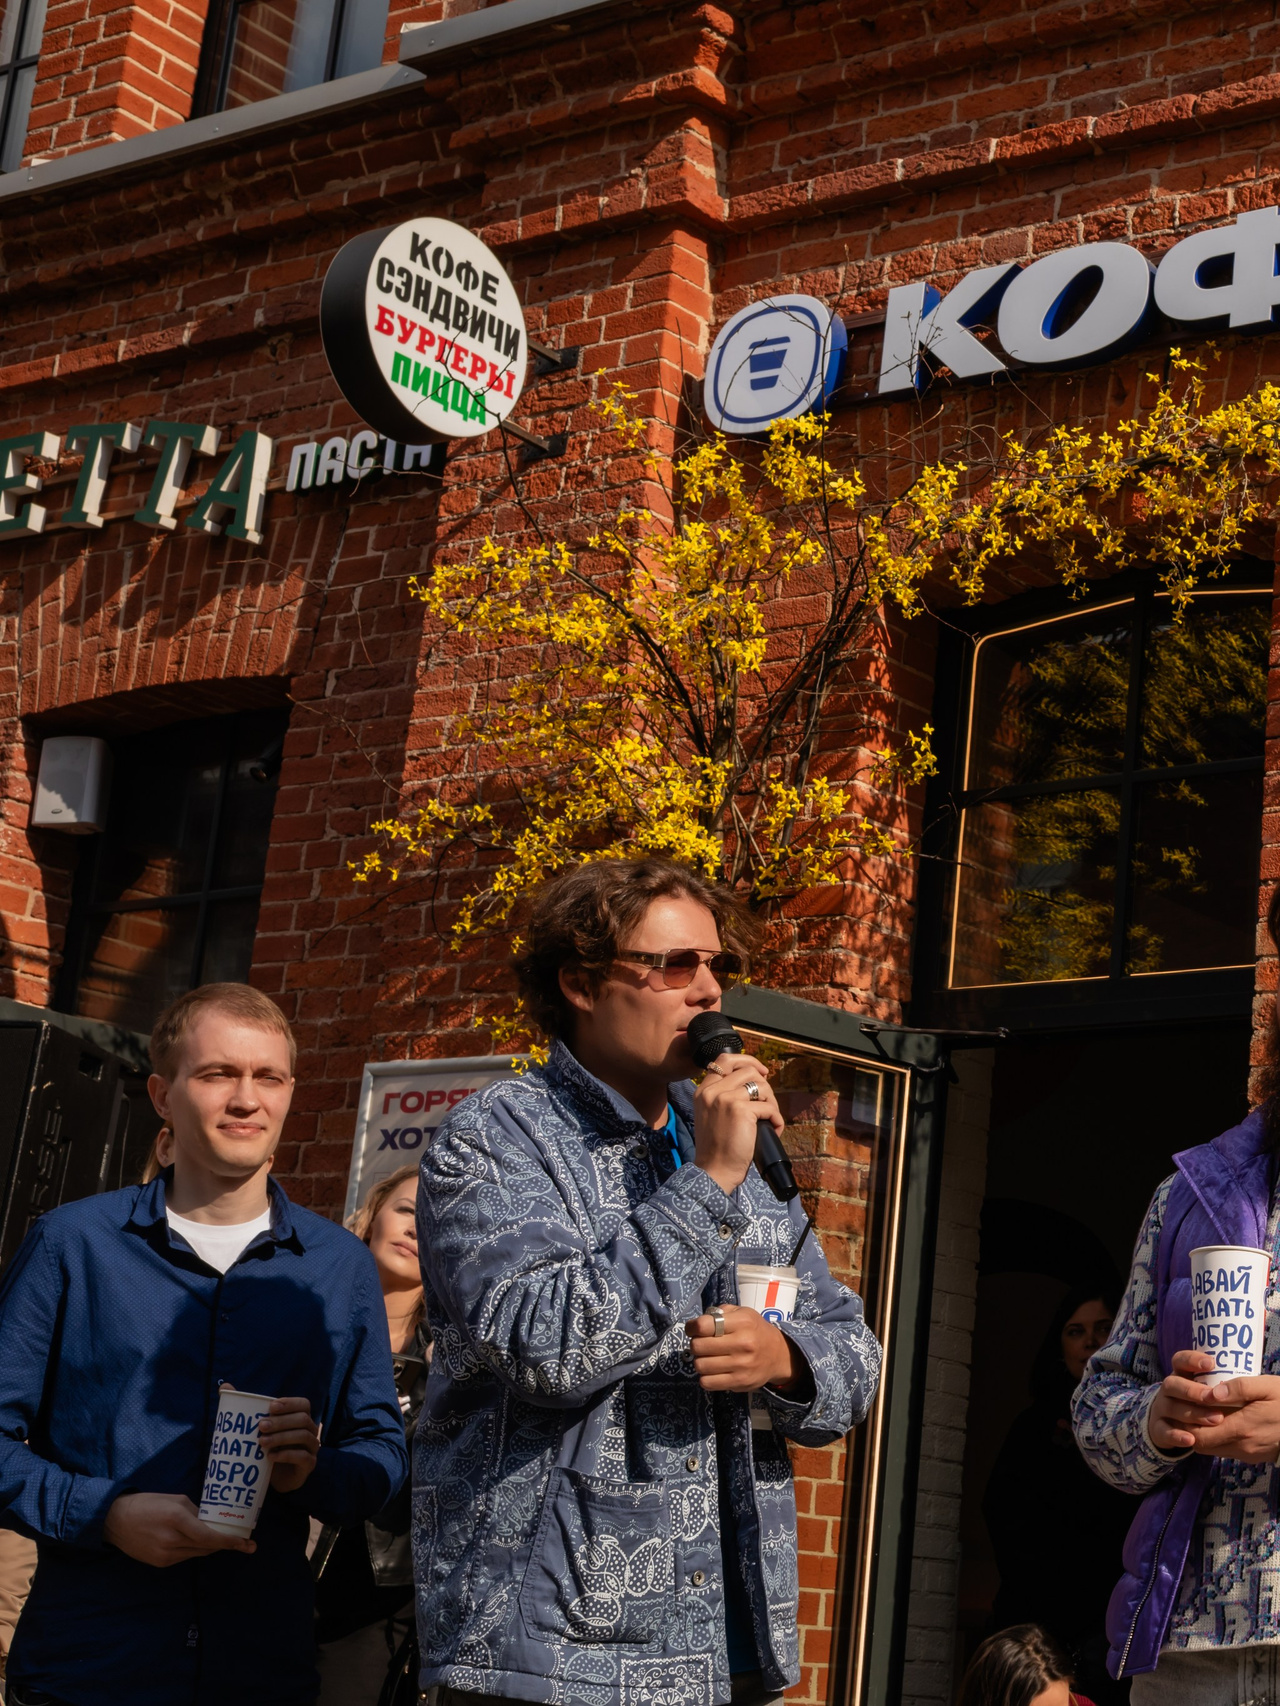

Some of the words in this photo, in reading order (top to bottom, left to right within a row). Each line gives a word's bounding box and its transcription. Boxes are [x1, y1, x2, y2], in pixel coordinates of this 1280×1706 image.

[409, 231, 500, 307] КОФЕ
[375, 256, 521, 362] СЭНДВИЧИ
[374, 303, 517, 400] БУРГЕРЫ
[390, 350, 487, 426] ПИЦЦА
[381, 1088, 478, 1115] ГОРЯ
[211, 1436, 265, 1461] ЕЛАТЬ
[215, 1411, 270, 1438] АВАЙ
[205, 1459, 260, 1487] ОБРО
